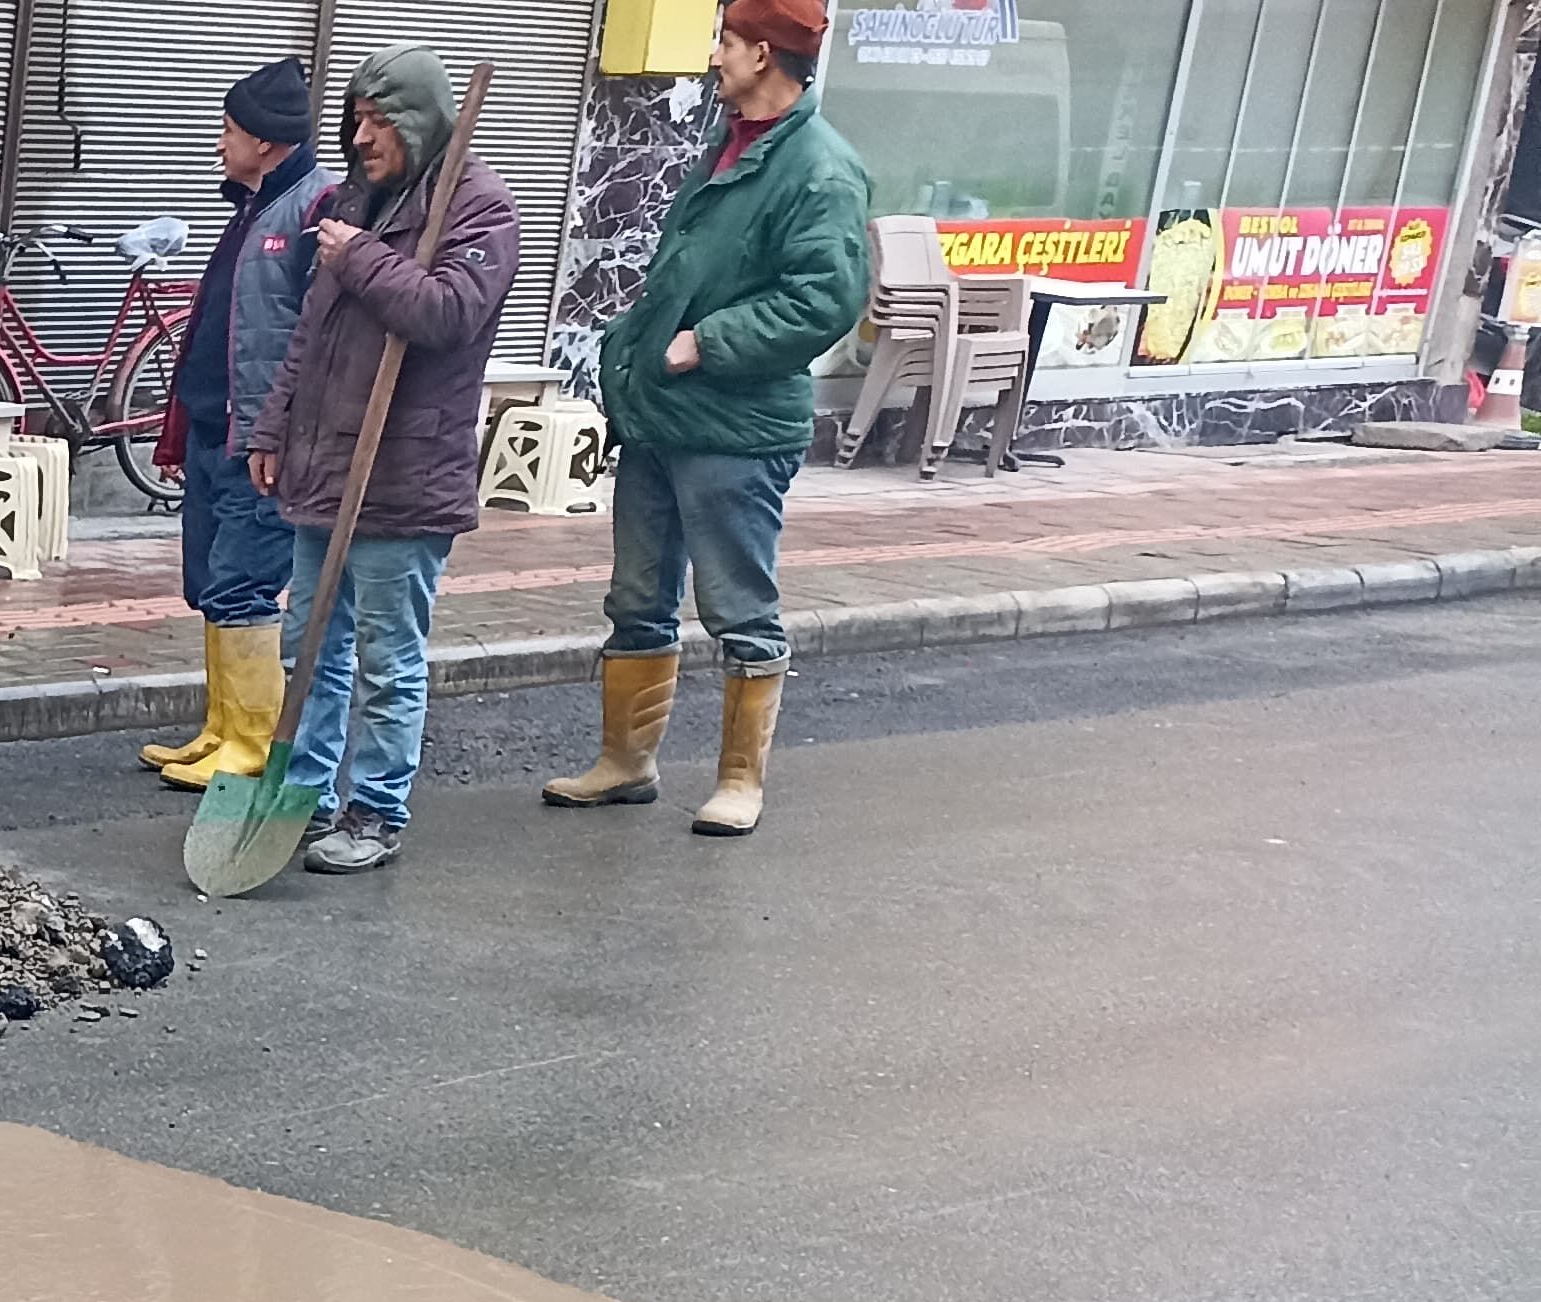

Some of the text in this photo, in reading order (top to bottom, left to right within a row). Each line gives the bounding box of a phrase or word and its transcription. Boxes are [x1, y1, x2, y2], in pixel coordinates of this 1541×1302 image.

[938, 218, 1132, 276] ZGARA ÇEŞİTLERİ
[1230, 222, 1385, 278] UMUT DÖNER
